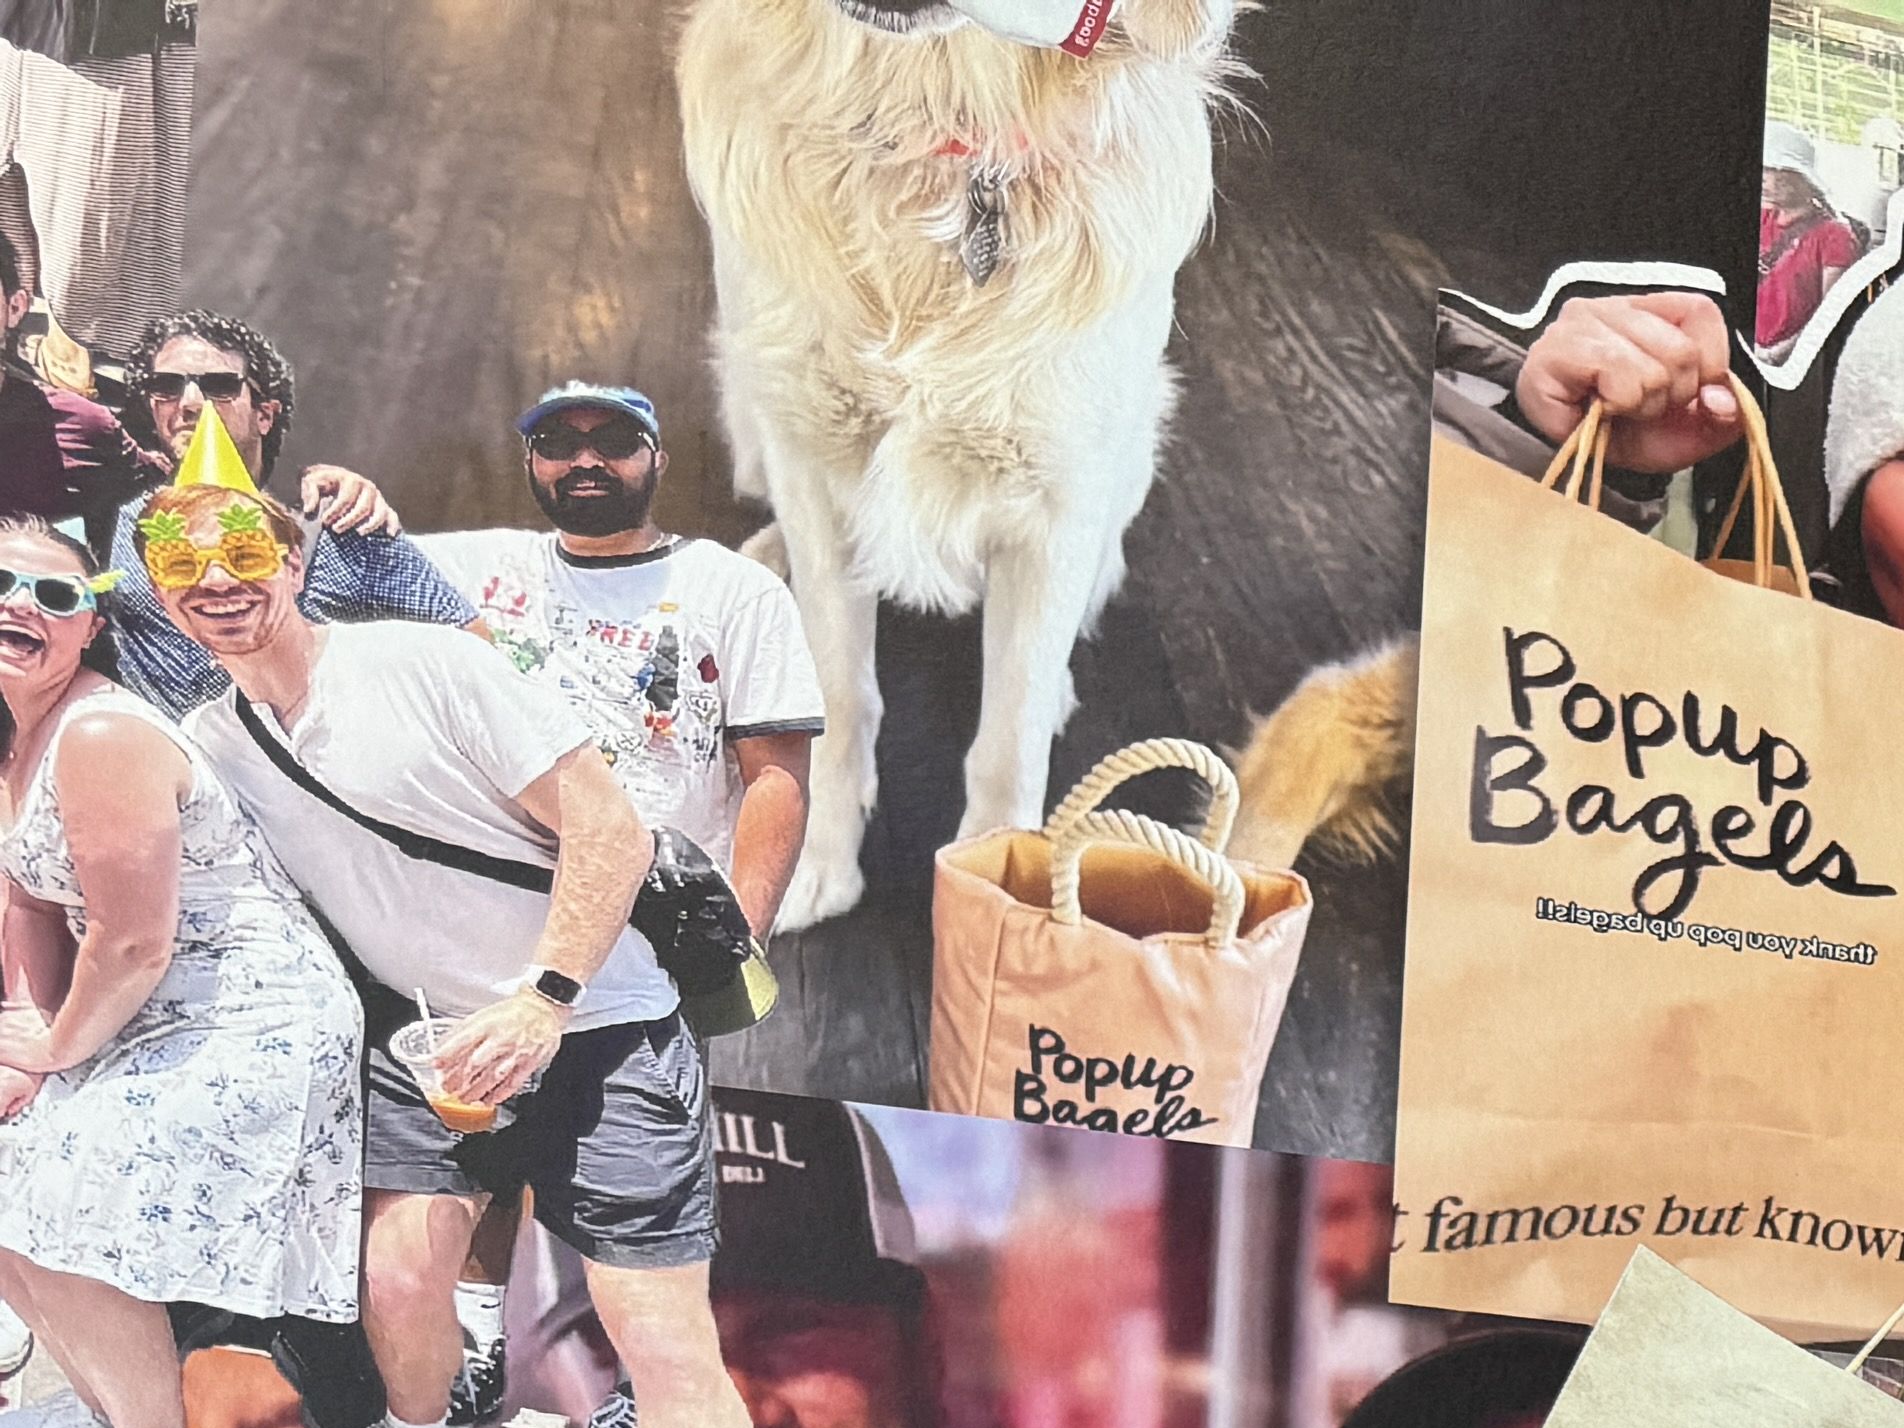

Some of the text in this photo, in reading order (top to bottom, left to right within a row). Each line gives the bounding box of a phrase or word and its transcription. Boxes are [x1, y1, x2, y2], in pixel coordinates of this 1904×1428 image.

[1470, 725, 1896, 920] Bagels
[1014, 1070, 1219, 1139] Bagels
[1421, 1196, 1644, 1254] famous
[1654, 1195, 1746, 1239] but
